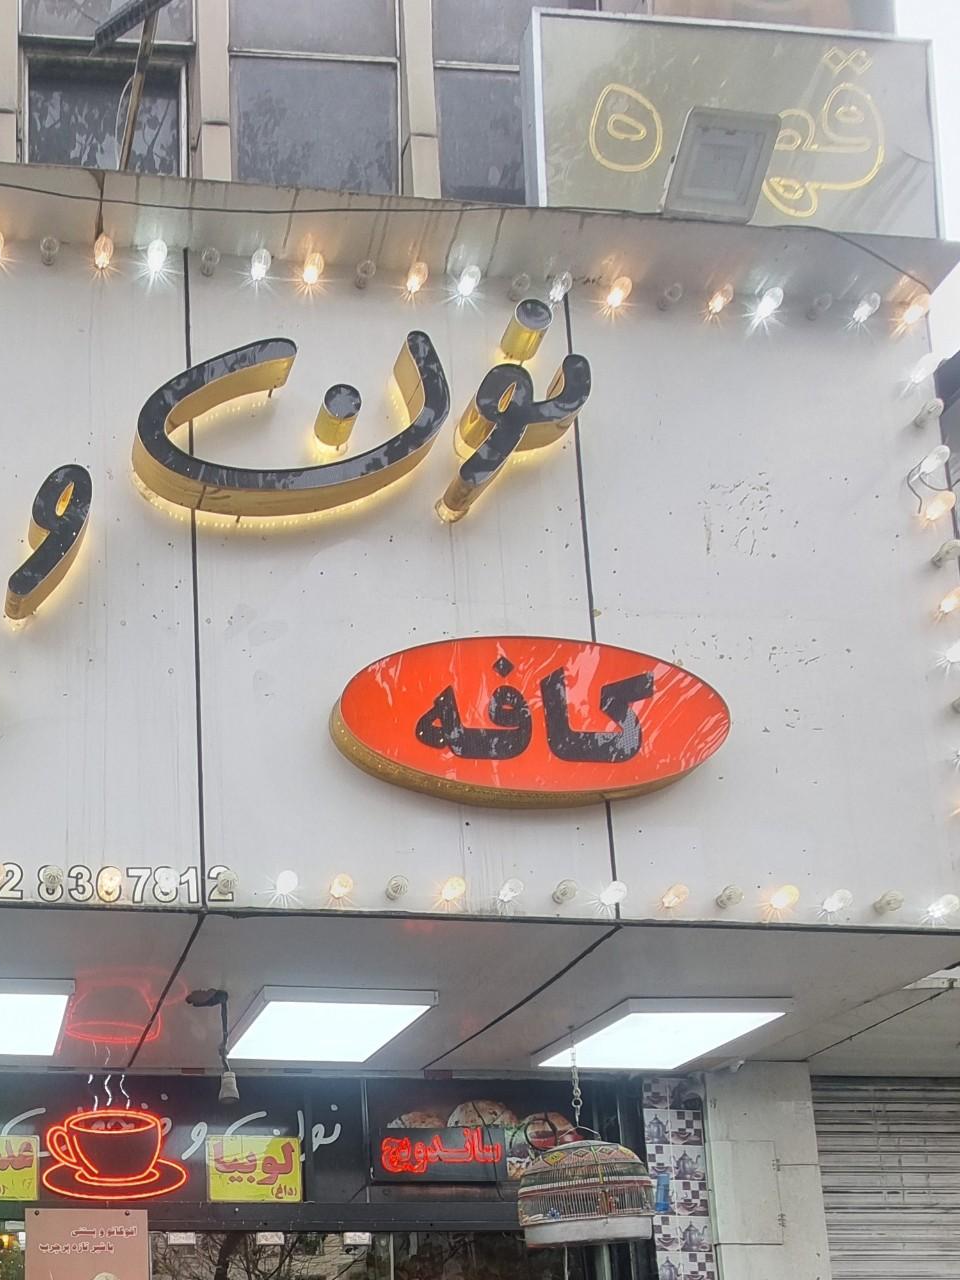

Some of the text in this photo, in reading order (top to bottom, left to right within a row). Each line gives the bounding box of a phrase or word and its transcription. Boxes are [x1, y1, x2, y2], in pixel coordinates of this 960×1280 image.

[134, 300, 592, 524] نون
[6, 464, 93, 620] و
[414, 657, 656, 764] کافه
[213, 1141, 296, 1185] لوبیا
[380, 1126, 503, 1174] ساندویچ
